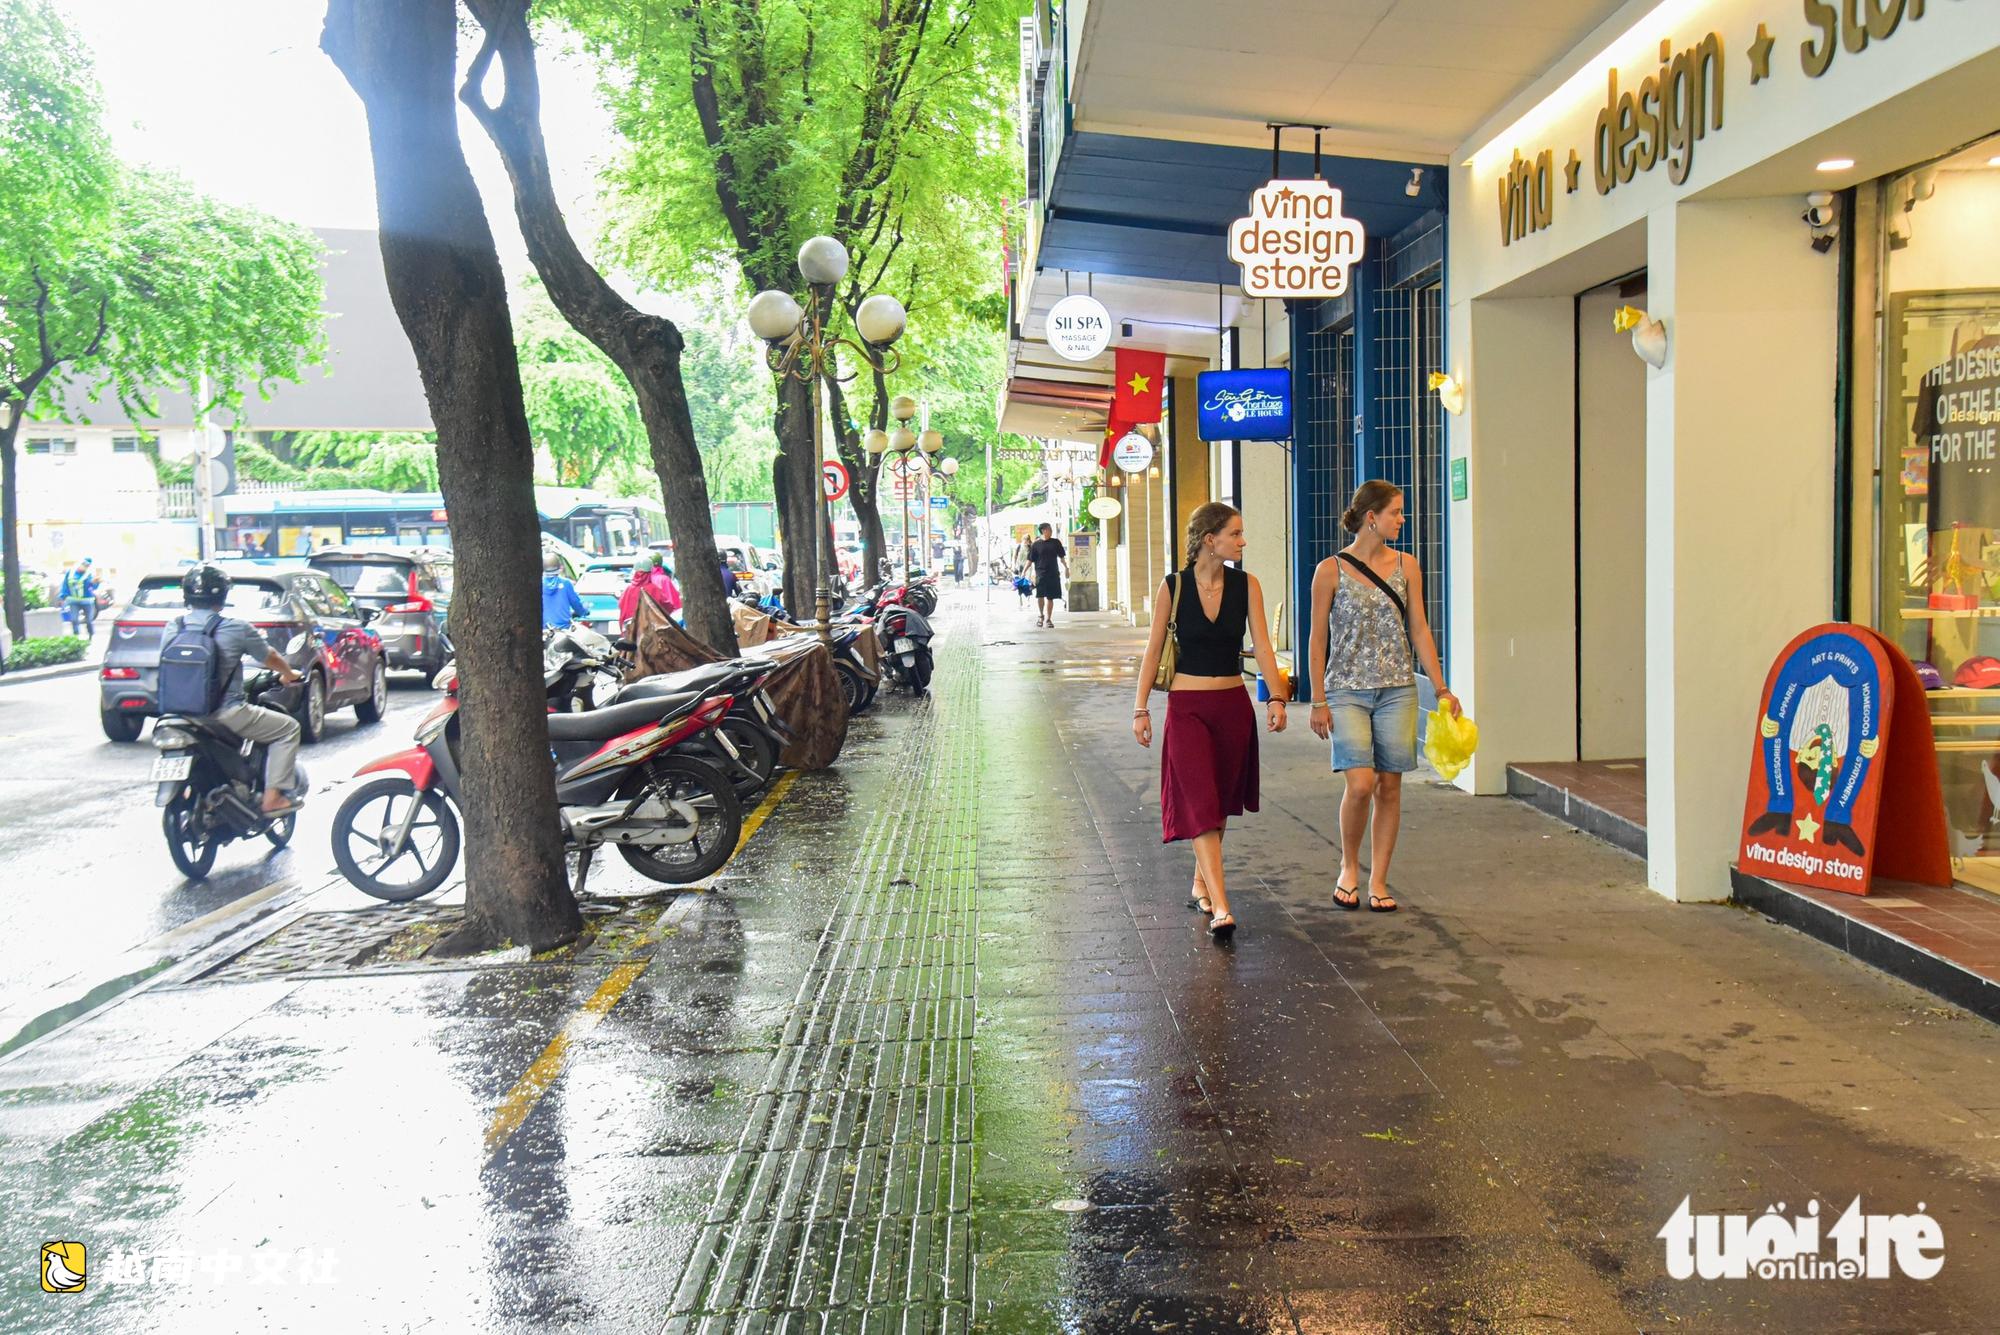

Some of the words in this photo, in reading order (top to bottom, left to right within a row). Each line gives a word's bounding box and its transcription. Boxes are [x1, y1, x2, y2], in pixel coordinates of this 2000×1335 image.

[1498, 148, 1553, 247] vina
[1594, 31, 1724, 197] design
[1261, 186, 1333, 219] vina
[1239, 220, 1354, 263] design
[1251, 258, 1341, 290] store
[1055, 316, 1072, 330] SII
[1077, 316, 1103, 330] SPA
[1061, 334, 1097, 342] MASSAGE
[1925, 362, 1952, 388] THE
[1257, 409, 1284, 417] HOUSE
[1936, 393, 1958, 424] OF
[1959, 387, 1991, 417] THE
[1931, 432, 1962, 464] FOR
[1964, 428, 1996, 461] THE
[1811, 652, 1826, 666] ART
[1827, 651, 1834, 660] &
[1834, 652, 1859, 675] PRINTS
[1779, 682, 1798, 719] APPAREL
[1774, 738, 1785, 796] ACCESSORIES
[1839, 756, 1864, 808] STATIONERY
[1746, 842, 1776, 864] vina
[1776, 847, 1823, 875] design
[1824, 858, 1864, 881] store
